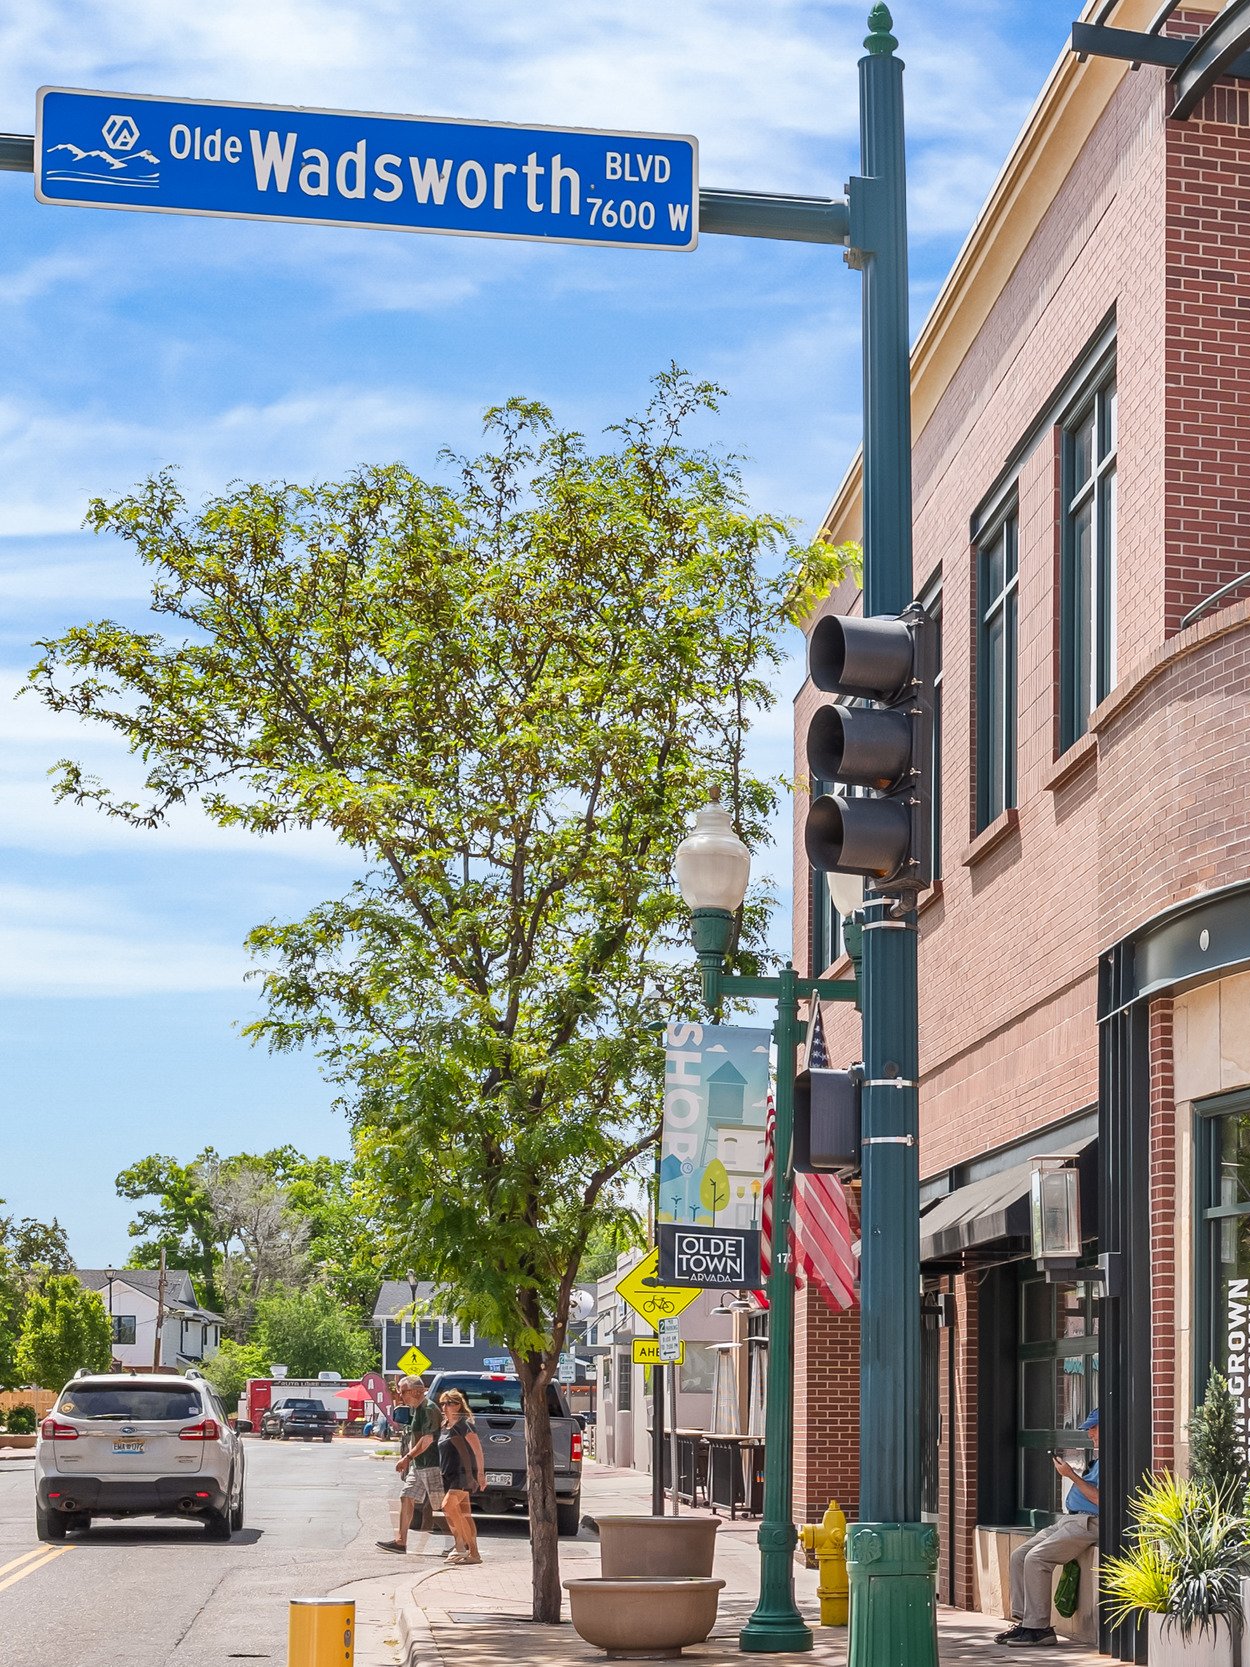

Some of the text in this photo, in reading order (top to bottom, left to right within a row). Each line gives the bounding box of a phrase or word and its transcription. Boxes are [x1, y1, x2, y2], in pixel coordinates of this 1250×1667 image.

[169, 123, 581, 216] Olde Wadsworth
[605, 151, 672, 184] BLVD
[586, 197, 690, 232] 7600 W
[661, 1023, 704, 1163] SHOP
[682, 1237, 737, 1257] OLDE
[678, 1255, 740, 1274] TOWN
[690, 1273, 732, 1283] ARVADA
[639, 1347, 660, 1357] AHE
